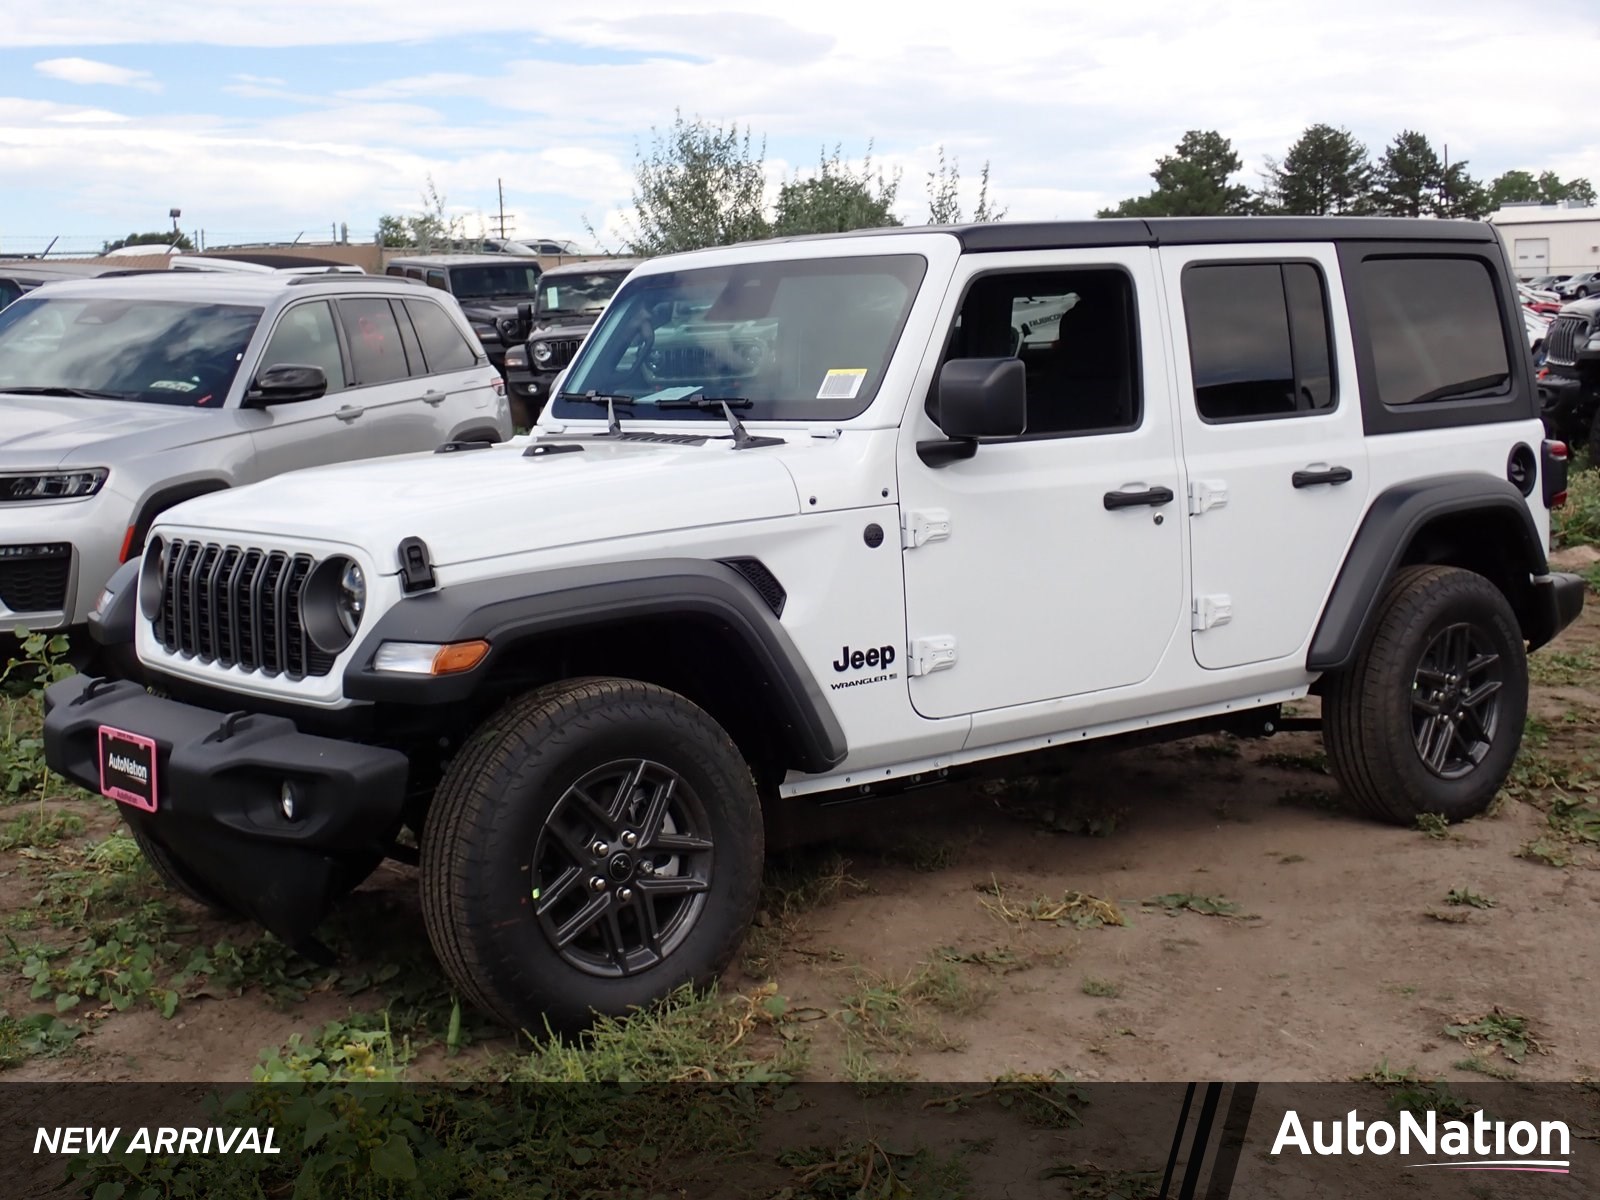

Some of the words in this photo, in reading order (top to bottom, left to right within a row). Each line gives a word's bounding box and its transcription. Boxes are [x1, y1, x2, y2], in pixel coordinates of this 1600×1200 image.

[833, 645, 896, 673] Jeep
[830, 674, 888, 691] WRANGLER
[108, 752, 148, 779] AutoNation
